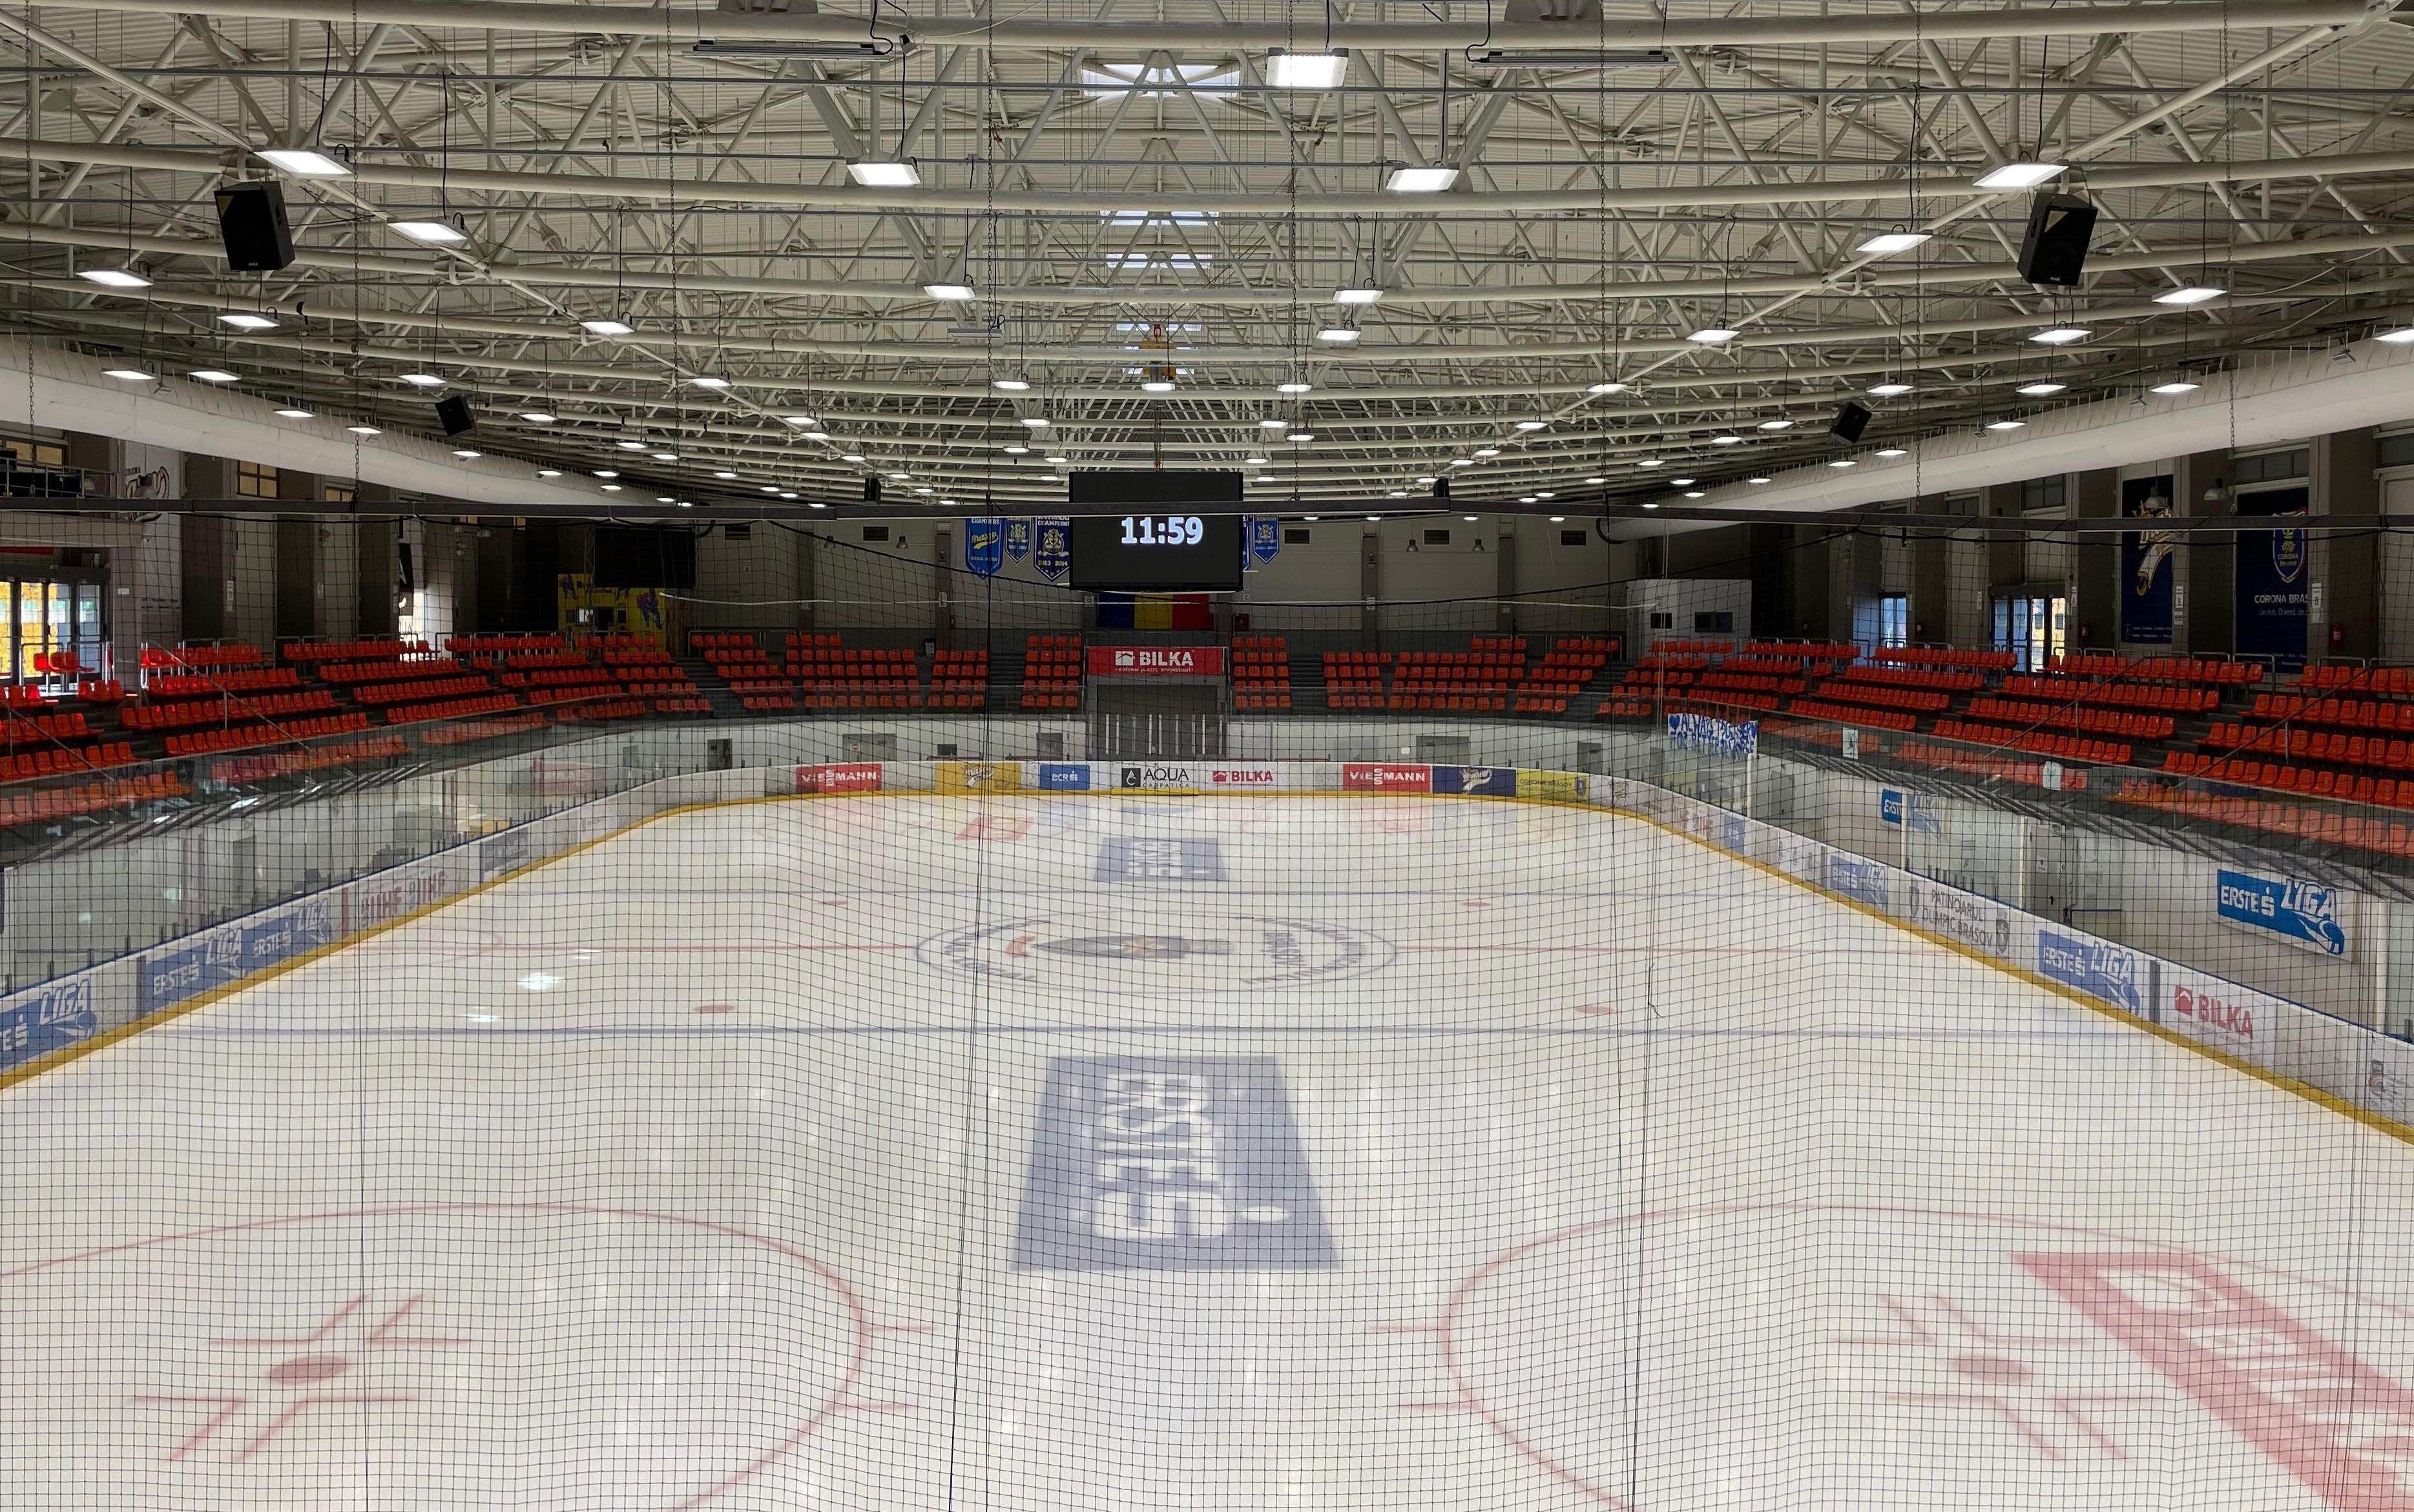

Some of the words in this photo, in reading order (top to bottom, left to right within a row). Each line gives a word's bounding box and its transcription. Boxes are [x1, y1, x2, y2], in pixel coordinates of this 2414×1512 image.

[1121, 517, 1203, 544] 11:59
[2254, 594, 2287, 603] CORONA
[1139, 652, 1193, 666] BILKA
[1143, 768, 1189, 780] AQUA
[1231, 771, 1273, 782] BILKA
[1931, 888, 1983, 922] PATINOARUL
[2281, 878, 2336, 922] LIGA
[206, 928, 242, 964] LIGA
[2090, 940, 2134, 985] LIGA
[39, 979, 90, 1026] LIGA
[2199, 993, 2254, 1039] BILKA
